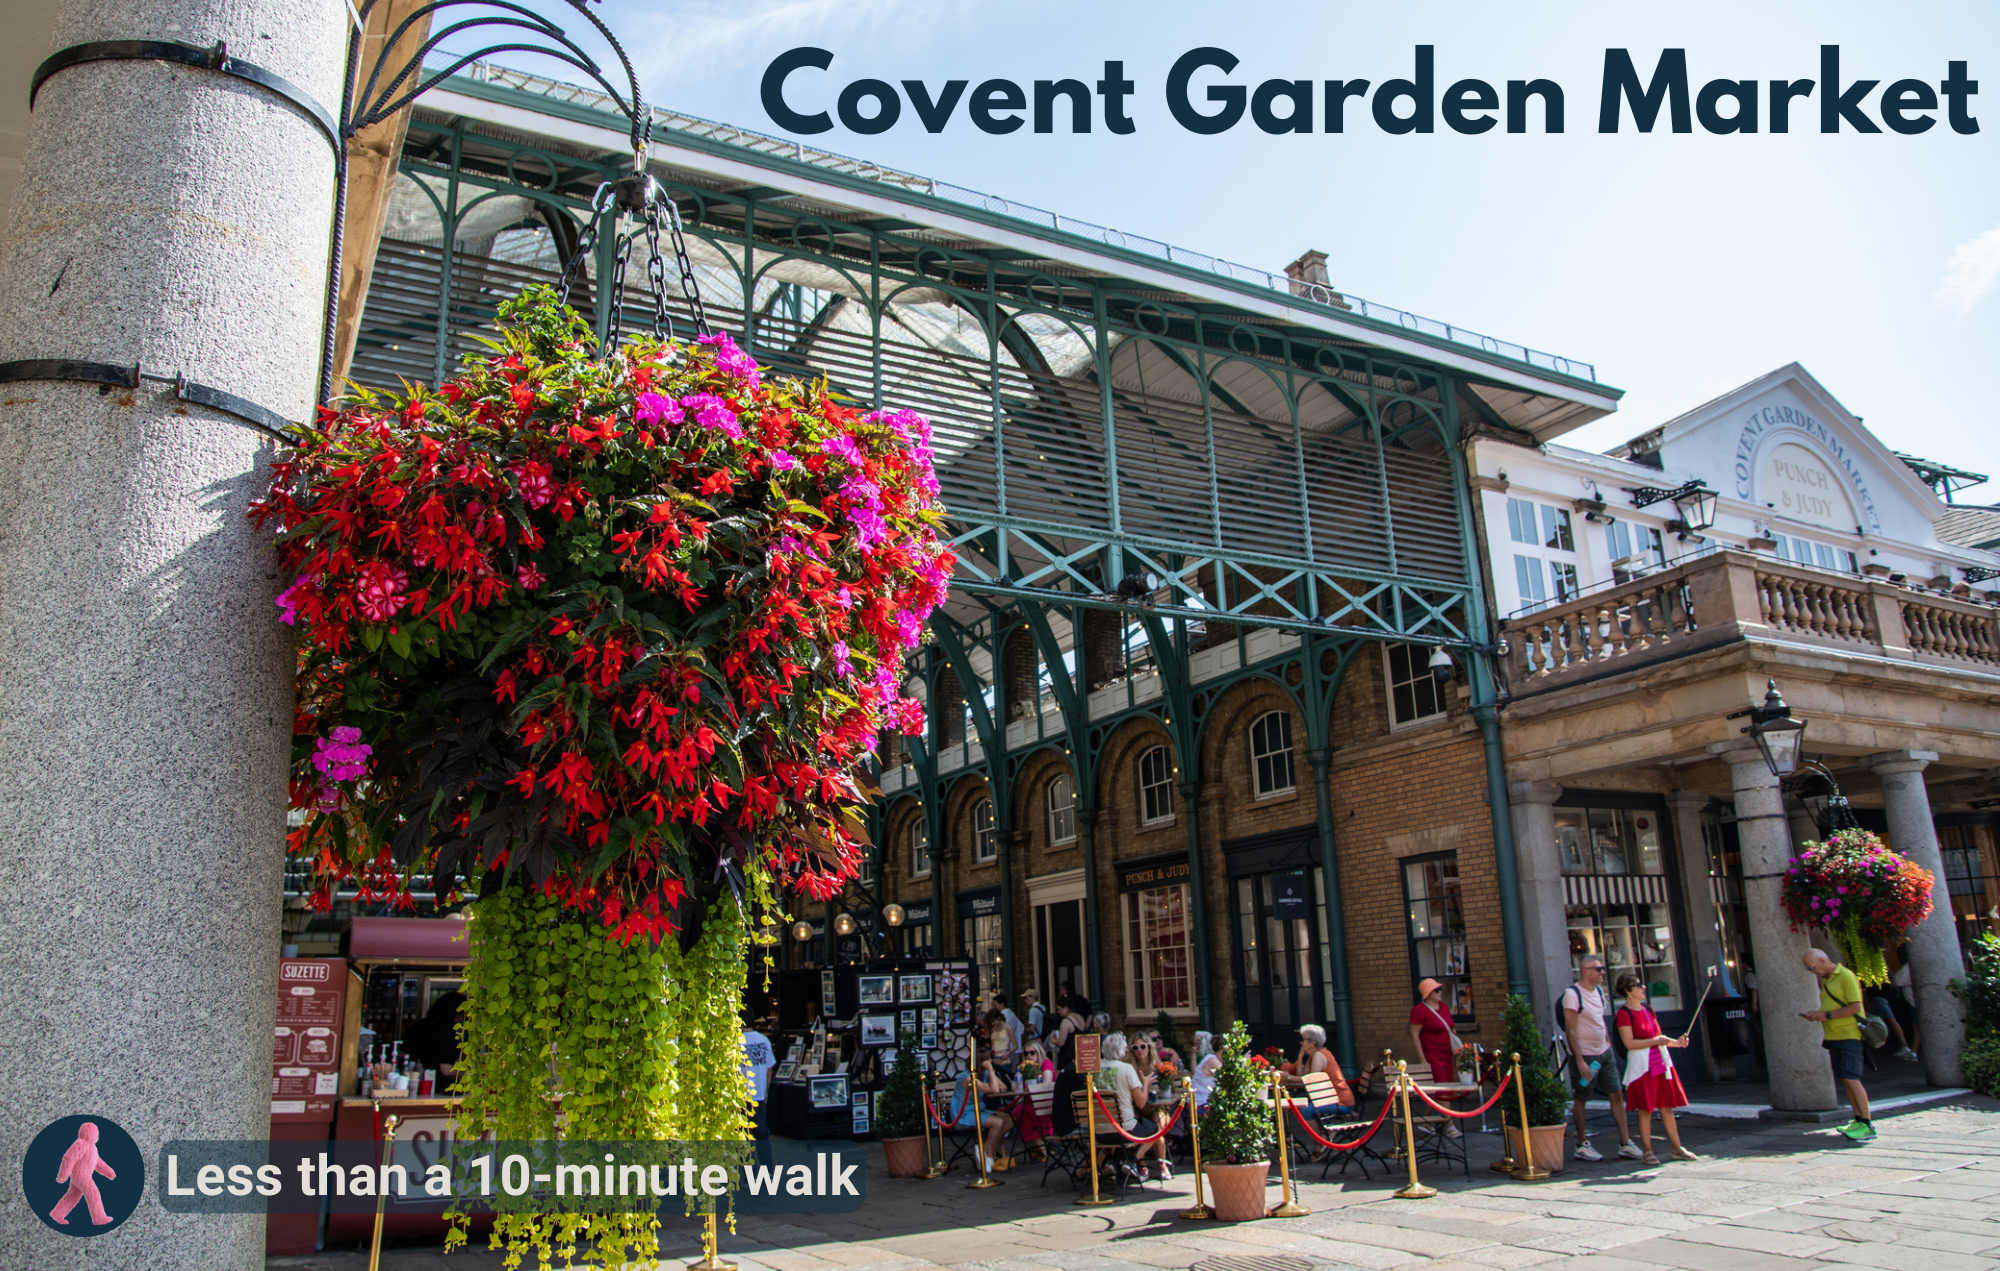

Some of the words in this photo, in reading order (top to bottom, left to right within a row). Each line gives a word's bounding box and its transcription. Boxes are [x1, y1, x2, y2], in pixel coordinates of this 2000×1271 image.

[1735, 413, 1763, 499] COVENT
[1762, 405, 1828, 443] GARDEN
[1829, 437, 1881, 533] MARKET
[1773, 459, 1830, 490] PUNCH
[1795, 492, 1833, 518] JUDY
[1125, 868, 1154, 886] PUNCH
[284, 965, 326, 979] SUZETTE
